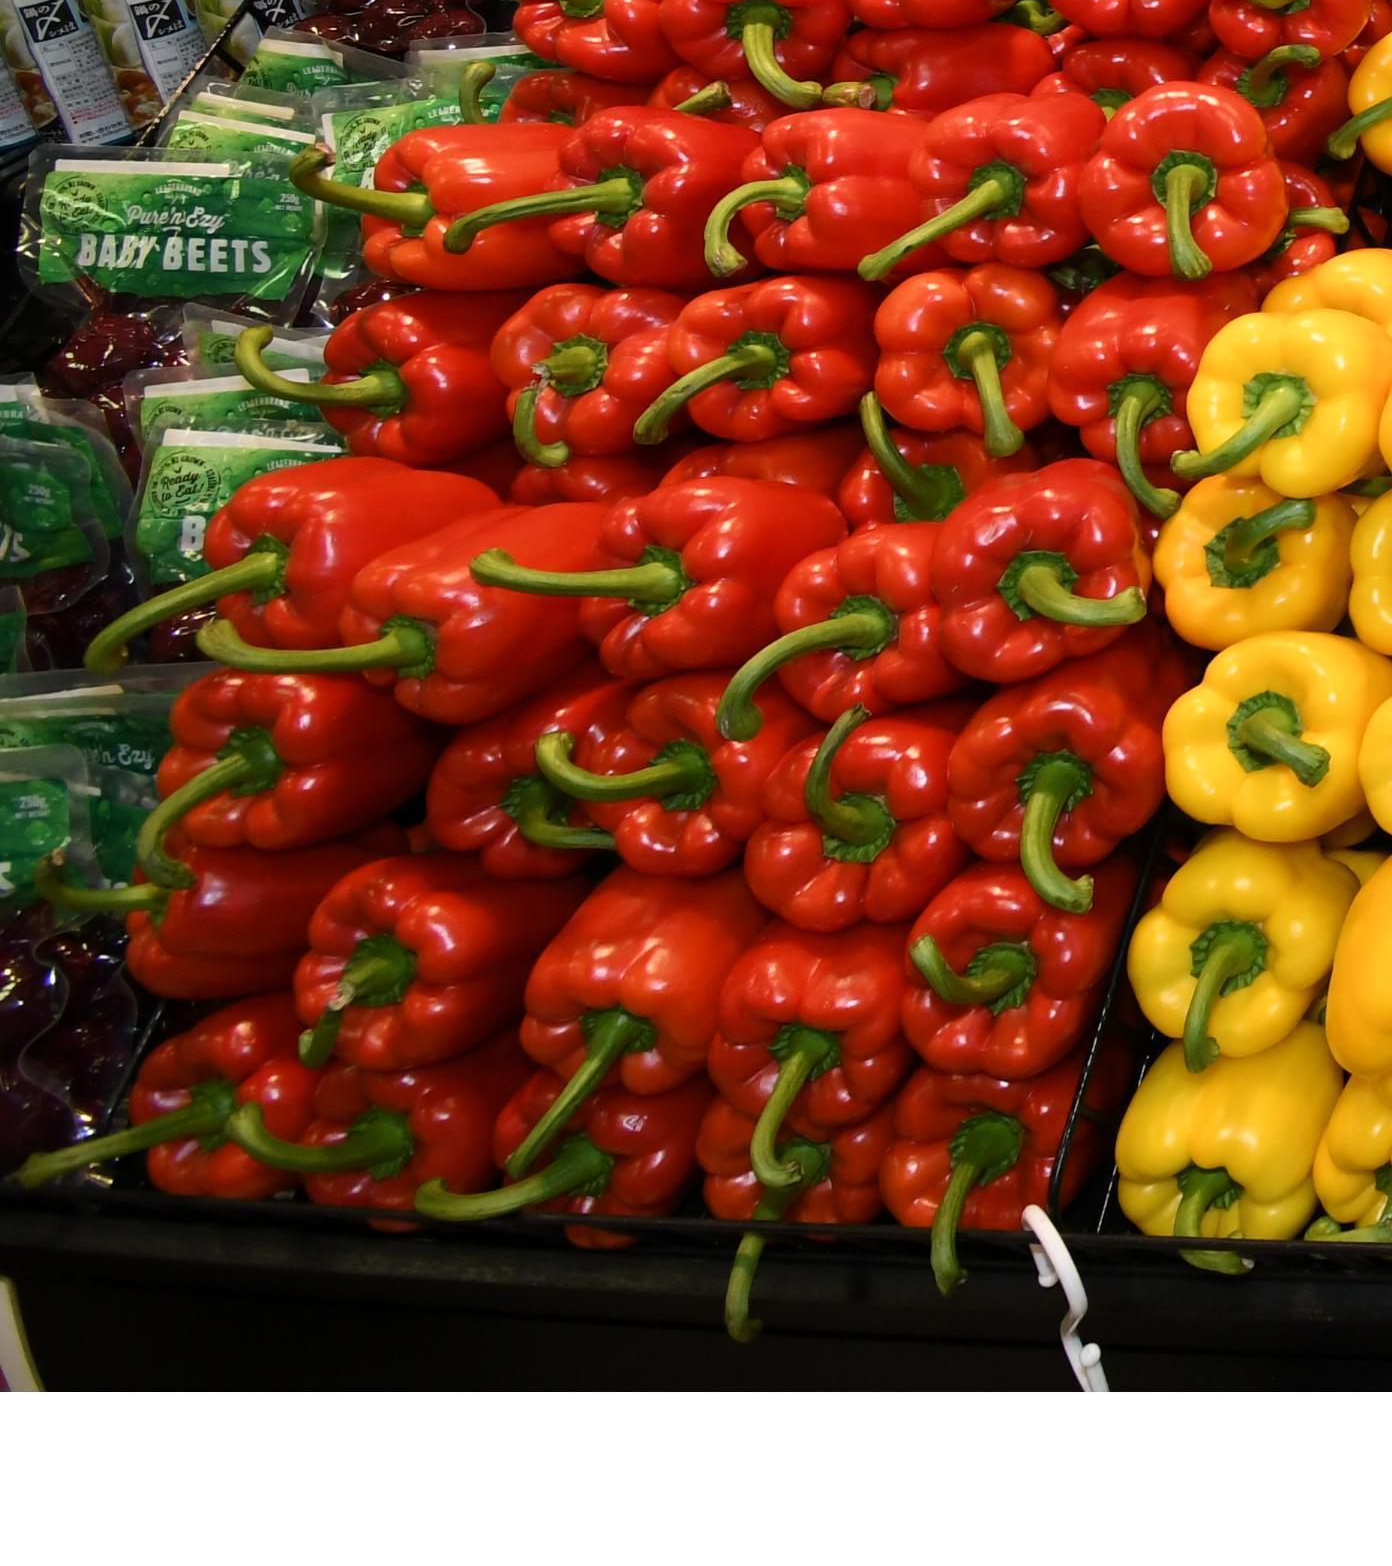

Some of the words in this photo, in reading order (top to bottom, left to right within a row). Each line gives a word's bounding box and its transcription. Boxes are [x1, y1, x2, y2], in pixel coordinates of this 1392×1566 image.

[126, 205, 185, 225] Pure'n
[185, 206, 225, 234] Ezy
[78, 233, 157, 269] BABY
[163, 237, 272, 274] BEETS
[161, 471, 199, 489] Ready
